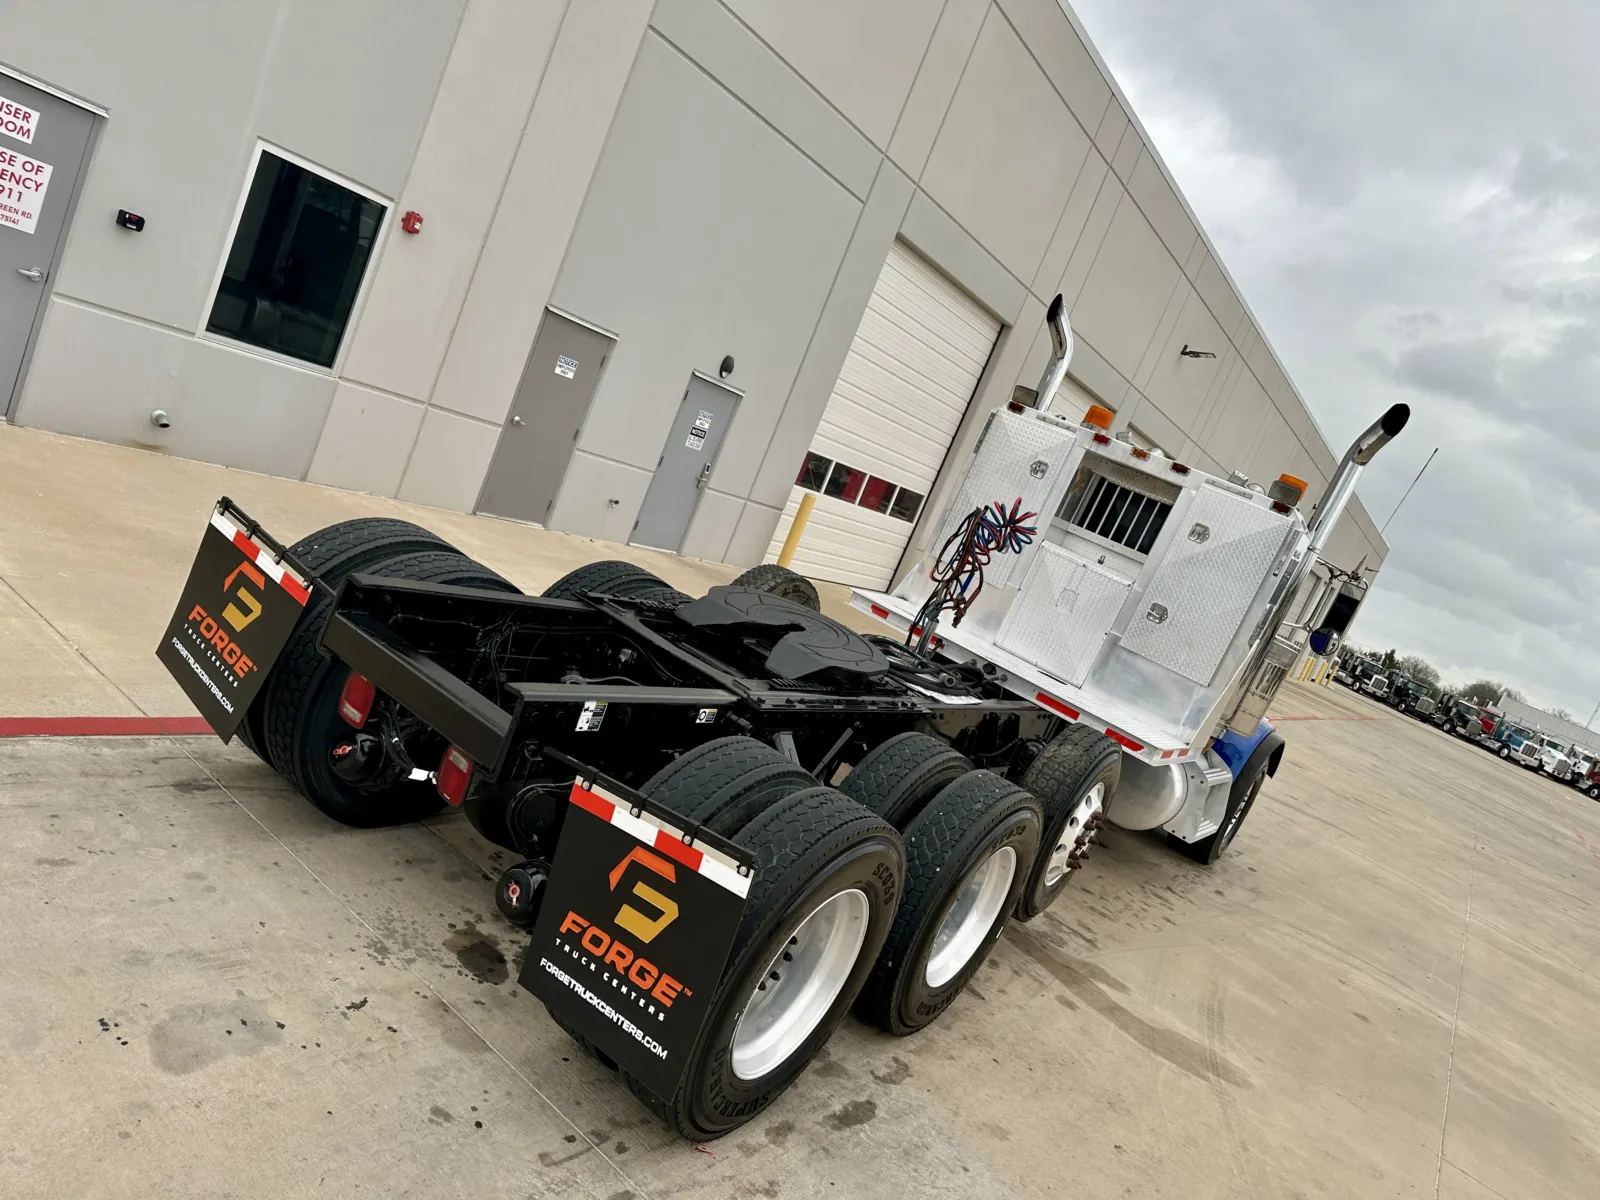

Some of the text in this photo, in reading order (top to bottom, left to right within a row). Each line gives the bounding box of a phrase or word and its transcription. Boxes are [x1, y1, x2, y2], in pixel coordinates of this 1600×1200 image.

[0, 168, 44, 193] ENCY
[22, 160, 45, 176] OF
[21, 210, 33, 220] RD.
[171, 636, 234, 714] FORGETRUCKCENTERS.COM
[183, 623, 239, 688] TRUCK CENTERS
[188, 604, 253, 679] FORGE
[555, 938, 665, 1022] TRUCK CENTERS
[559, 910, 684, 1008] FORGE
[540, 957, 668, 1060] FORGETRUCKCENTERS.COM
[708, 1045, 770, 1118] SUPERCARGO
